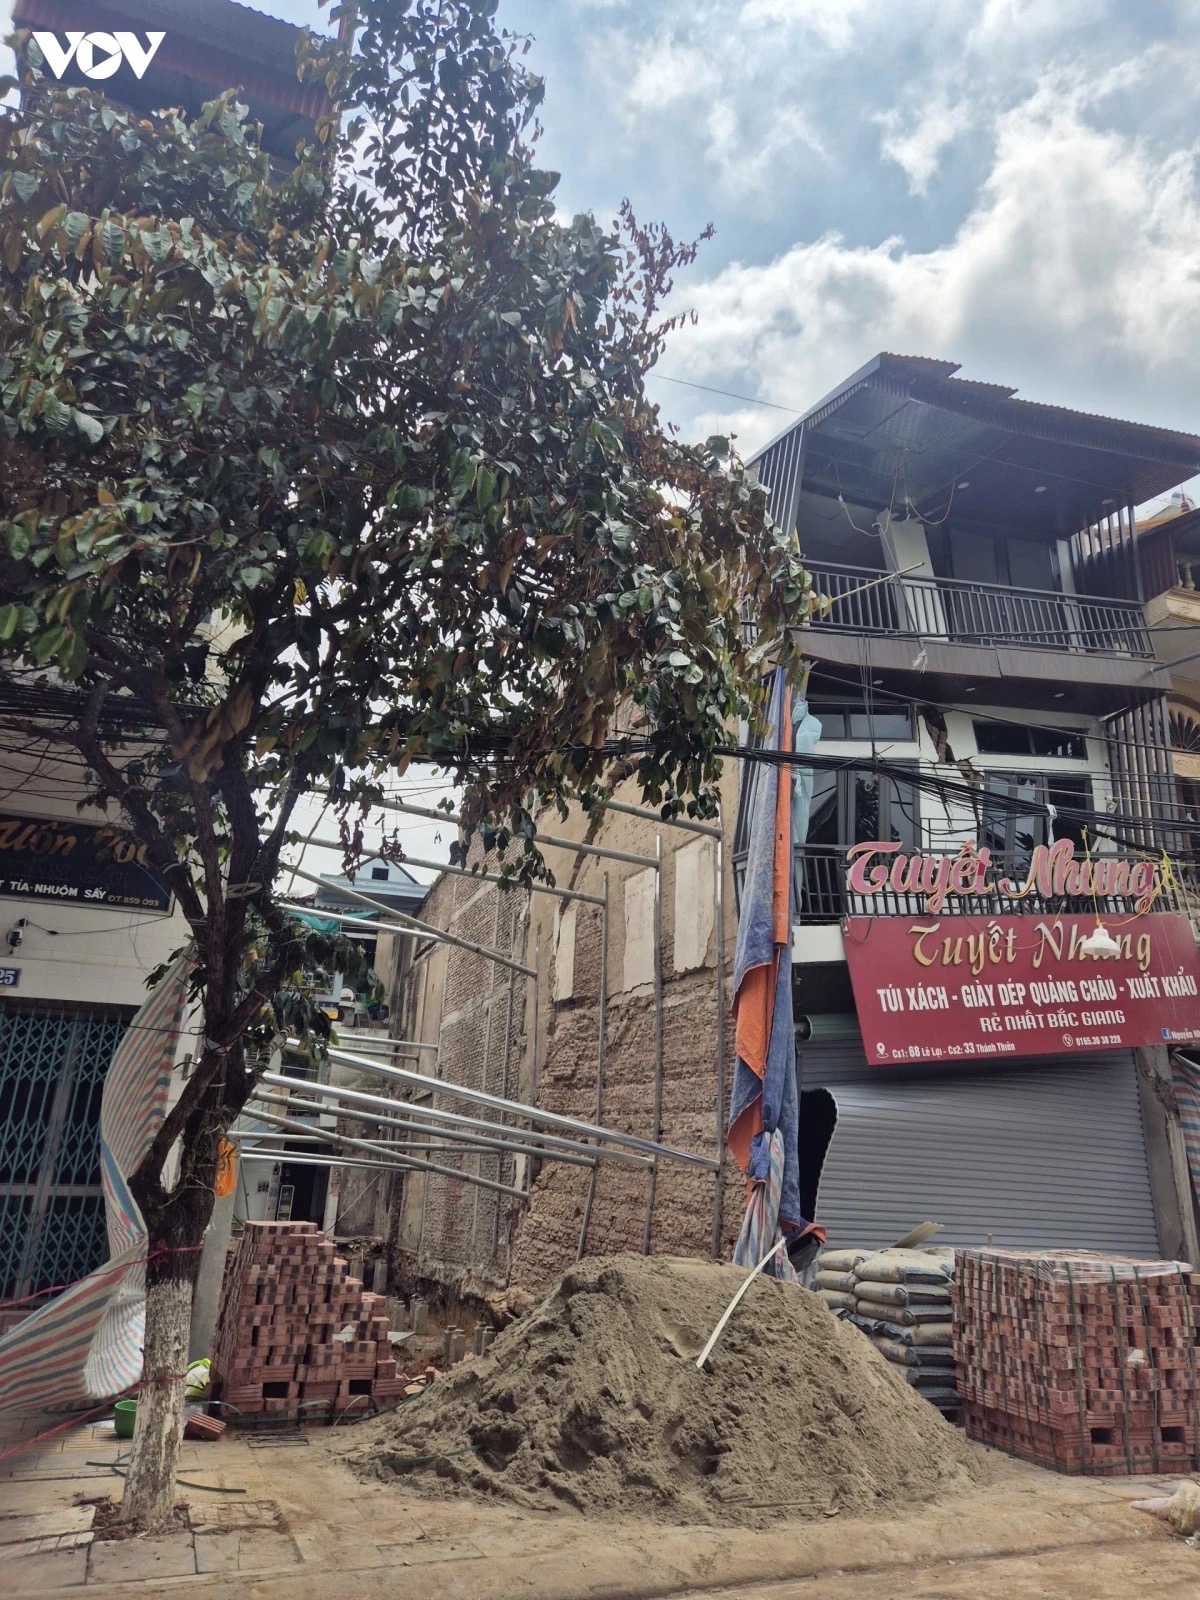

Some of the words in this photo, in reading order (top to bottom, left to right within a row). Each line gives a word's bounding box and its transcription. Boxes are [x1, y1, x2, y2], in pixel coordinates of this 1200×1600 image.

[84, 887, 107, 900] SẤY
[847, 839, 993, 913] Tuyết
[1000, 838, 1161, 914] Nhung
[908, 921, 1018, 976] Tuyết
[1032, 920, 1151, 971] Nhng
[877, 984, 904, 1012] TÚI
[906, 982, 949, 1010] XÁCH
[961, 979, 995, 1008] GIÀY
[998, 978, 1026, 1006] DÉP
[1030, 974, 1078, 1006] QUẢNG
[1080, 974, 1117, 1001] CHÂU
[1126, 971, 1161, 998] XUẤT
[1162, 966, 1198, 996] KHẨU
[980, 1013, 1003, 1032] RẺ
[1005, 1009, 1044, 1030] NHẤT
[1046, 1008, 1079, 1028] BẮC
[1082, 1010, 1126, 1025] GIANG
[909, 1046, 920, 1057] 68
[963, 1042, 975, 1053] 33
